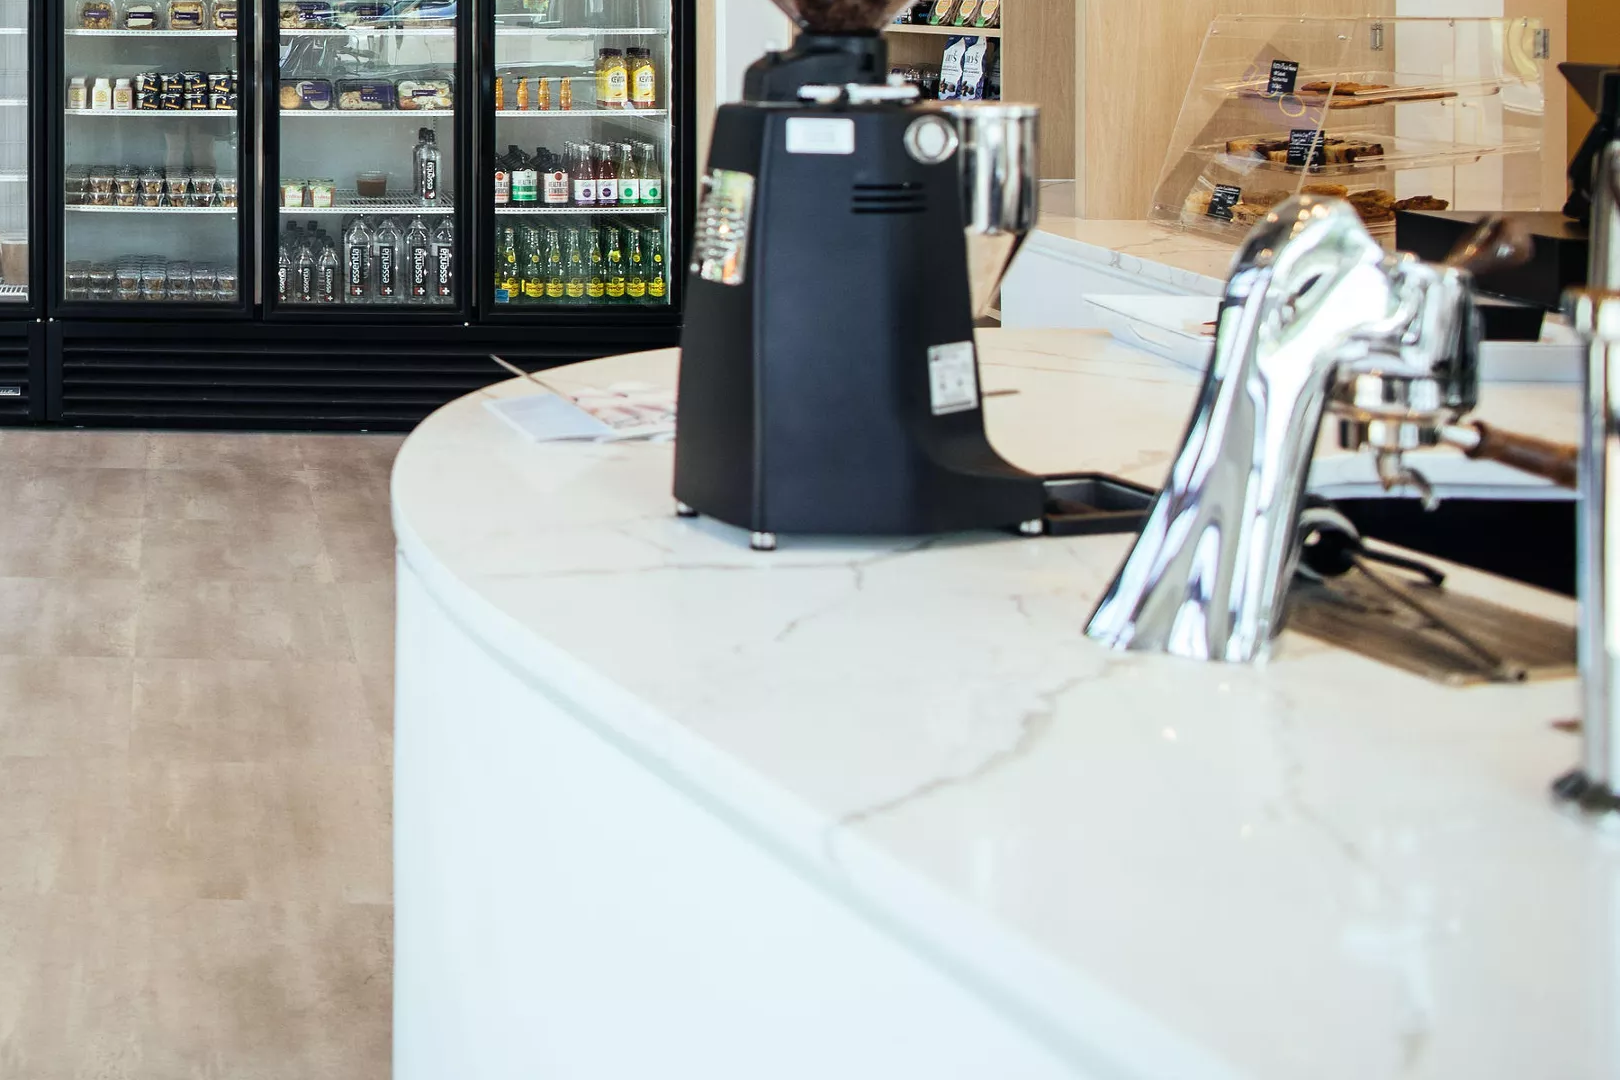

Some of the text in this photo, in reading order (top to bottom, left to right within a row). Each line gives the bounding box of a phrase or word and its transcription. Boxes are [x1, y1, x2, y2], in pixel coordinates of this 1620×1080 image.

[351, 248, 360, 284] essentia
[381, 247, 390, 284] essentia
[414, 247, 423, 284] essentia
[440, 247, 449, 284] essentia
